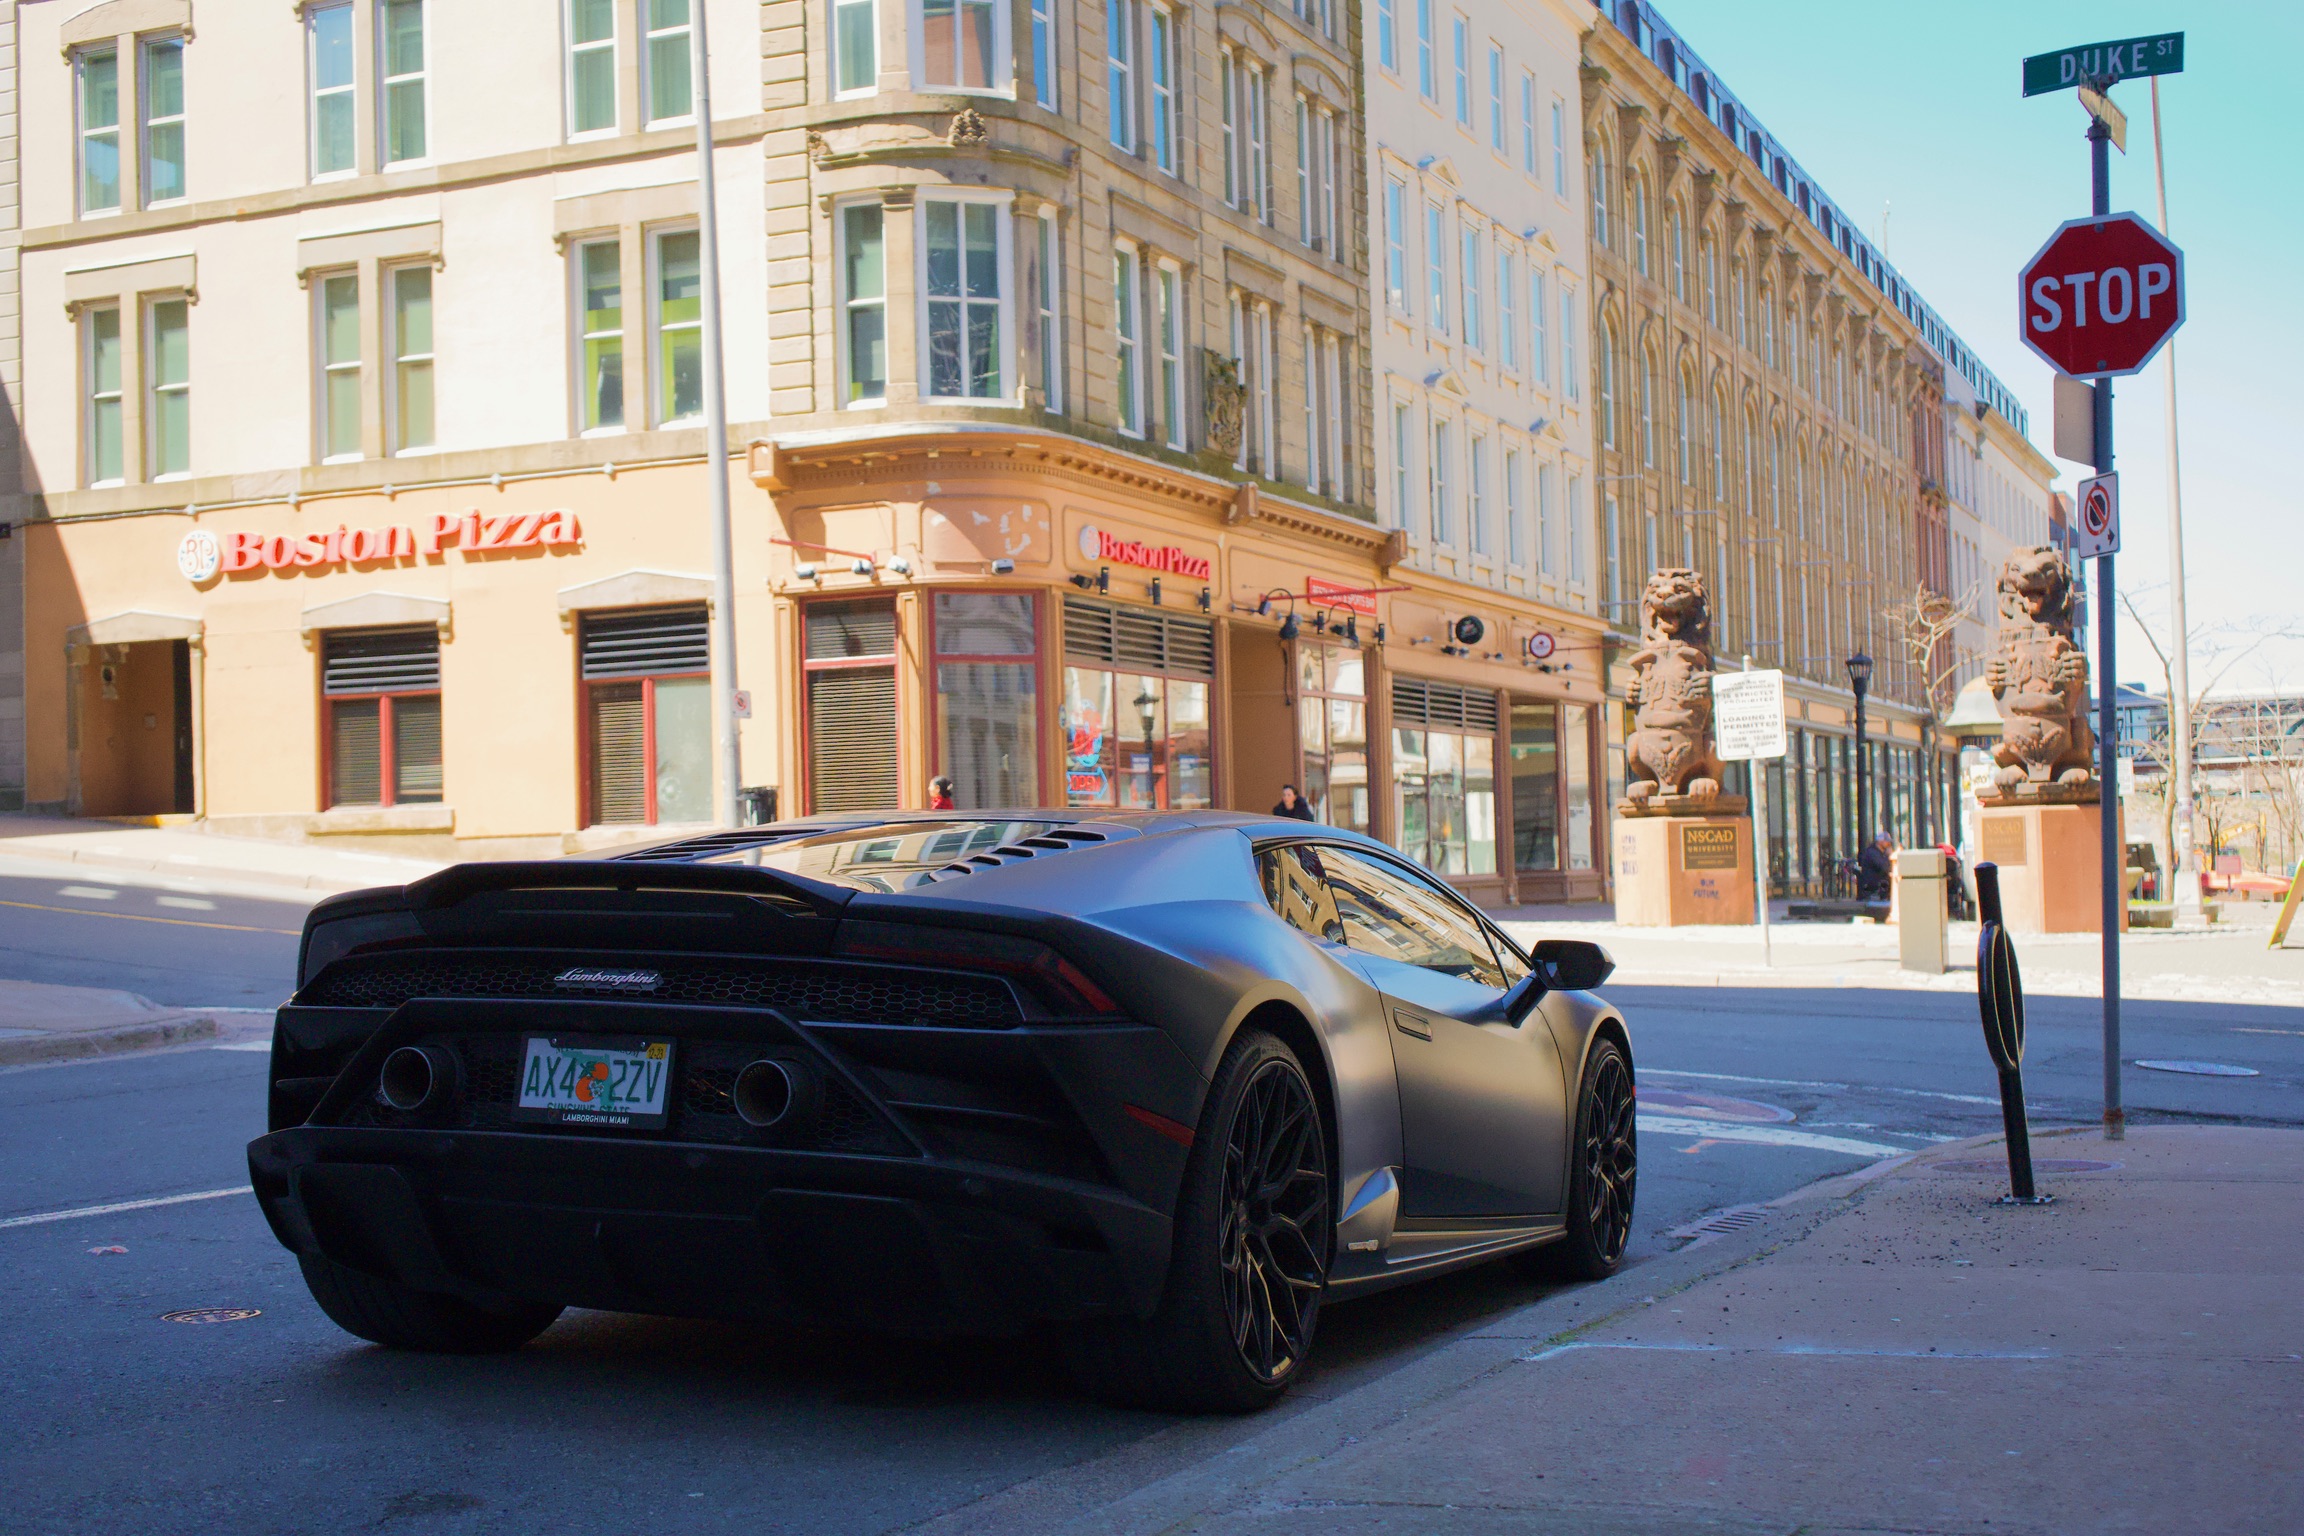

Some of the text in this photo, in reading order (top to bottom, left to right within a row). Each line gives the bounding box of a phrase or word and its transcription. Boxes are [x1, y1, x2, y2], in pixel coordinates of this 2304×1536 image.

[2060, 39, 2175, 83] DUKE ST
[2031, 262, 2171, 333] STOP
[219, 507, 580, 573] Boston Pizza
[1098, 530, 1164, 570] Boston
[1162, 546, 1210, 581] Pizza
[1724, 696, 1775, 704] PROHIBITED
[1734, 690, 1774, 698] STRICTLY
[1722, 714, 1766, 723] LOADING
[1723, 721, 1778, 730] PERMITTED
[1070, 775, 1101, 791] OPEN
[1687, 844, 1734, 853] UNIVERSITY
[554, 967, 659, 986] Lamborghini
[562, 1113, 630, 1125] LAMBORGHINI MIAMI
